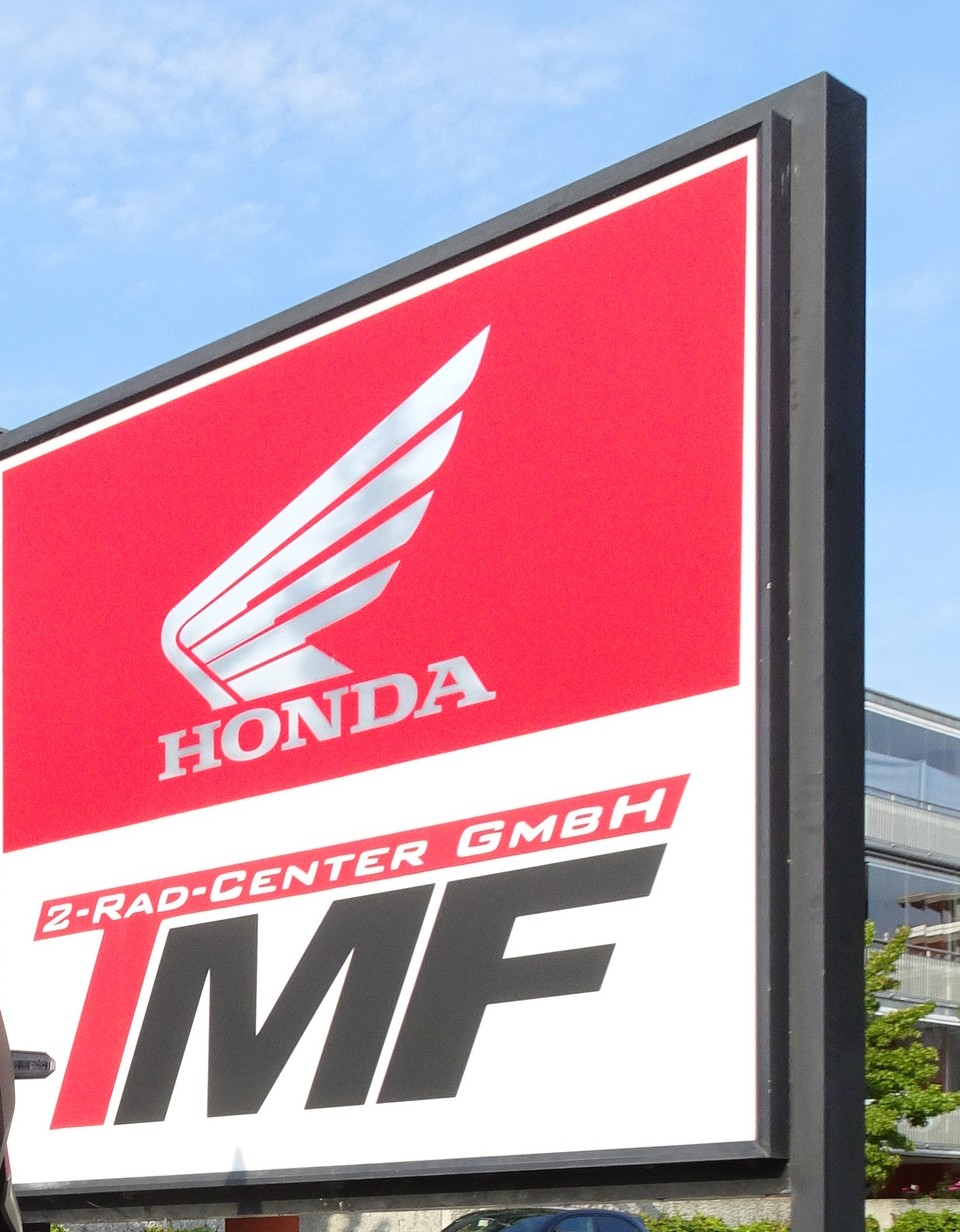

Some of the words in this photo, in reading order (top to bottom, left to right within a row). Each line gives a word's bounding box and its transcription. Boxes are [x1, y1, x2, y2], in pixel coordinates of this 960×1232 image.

[158, 655, 496, 781] HONDA
[42, 839, 428, 933] 2-RAD-CENTER
[36, 842, 668, 1130] TMF
